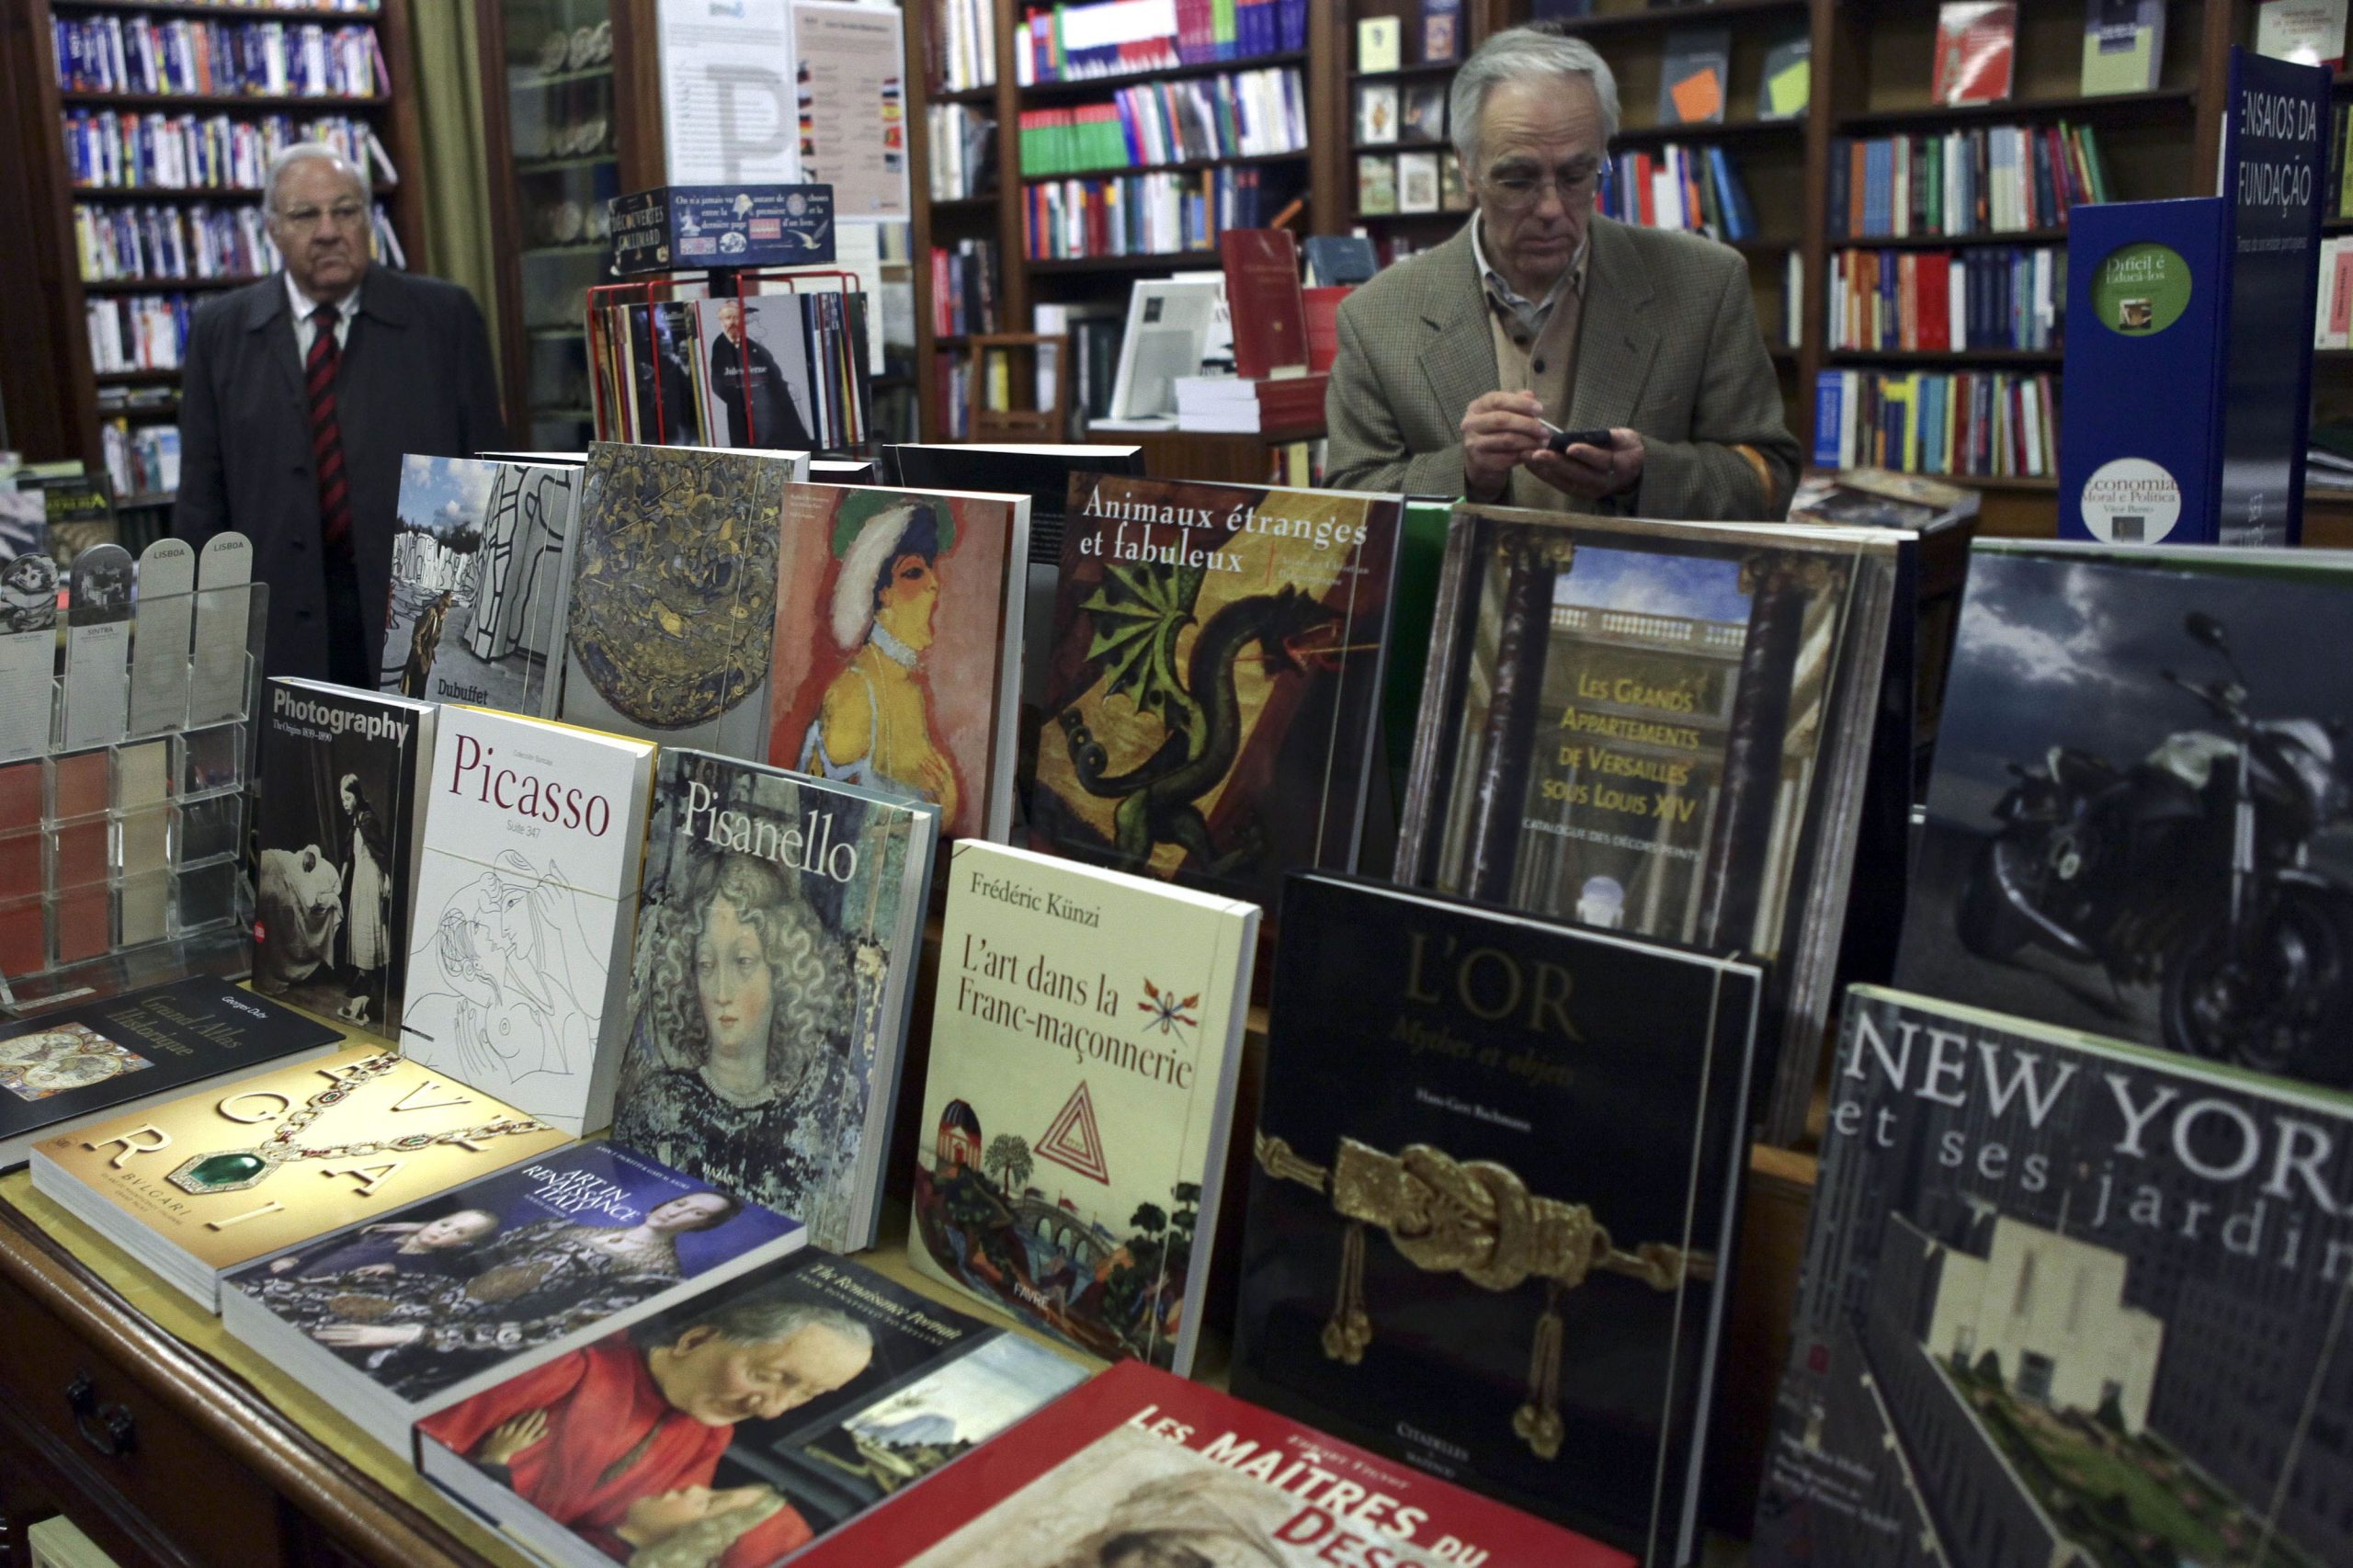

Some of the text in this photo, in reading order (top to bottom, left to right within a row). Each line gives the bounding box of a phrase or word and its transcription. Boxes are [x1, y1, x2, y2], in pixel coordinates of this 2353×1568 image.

[2298, 99, 2317, 141] DA
[1082, 483, 1369, 551] Animaux étranges
[153, 549, 186, 560] LISBOA
[214, 541, 244, 552] LISBOA
[1080, 530, 1103, 557] et
[1113, 521, 1244, 574] fabuleux
[87, 627, 114, 636] SINTRA
[273, 687, 409, 748] Photography
[438, 678, 488, 706] Dubuffet
[449, 733, 610, 837] Picasso
[526, 824, 541, 838] 347
[681, 779, 858, 884] Pisanello
[970, 871, 1101, 928] Frédéric Künzi
[962, 933, 1120, 1017] L'art dans la
[1404, 930, 1586, 1045] L'OR
[106, 1007, 194, 1055] Historique
[142, 995, 246, 1049] Grand Atlas
[958, 976, 1193, 1090] Franc-maçonnerie
[1844, 1011, 2353, 1215] NEW YOR
[1835, 1097, 1896, 1148] et
[1938, 1129, 2052, 1193] ses
[522, 1165, 641, 1222] RENAISSANCE
[563, 1169, 631, 1202] ART IN
[1129, 1404, 1195, 1447] LES
[1199, 1431, 1429, 1541] MAÎTRES
[1428, 1534, 1491, 1568] DU
[1272, 1506, 1426, 1568] DES
